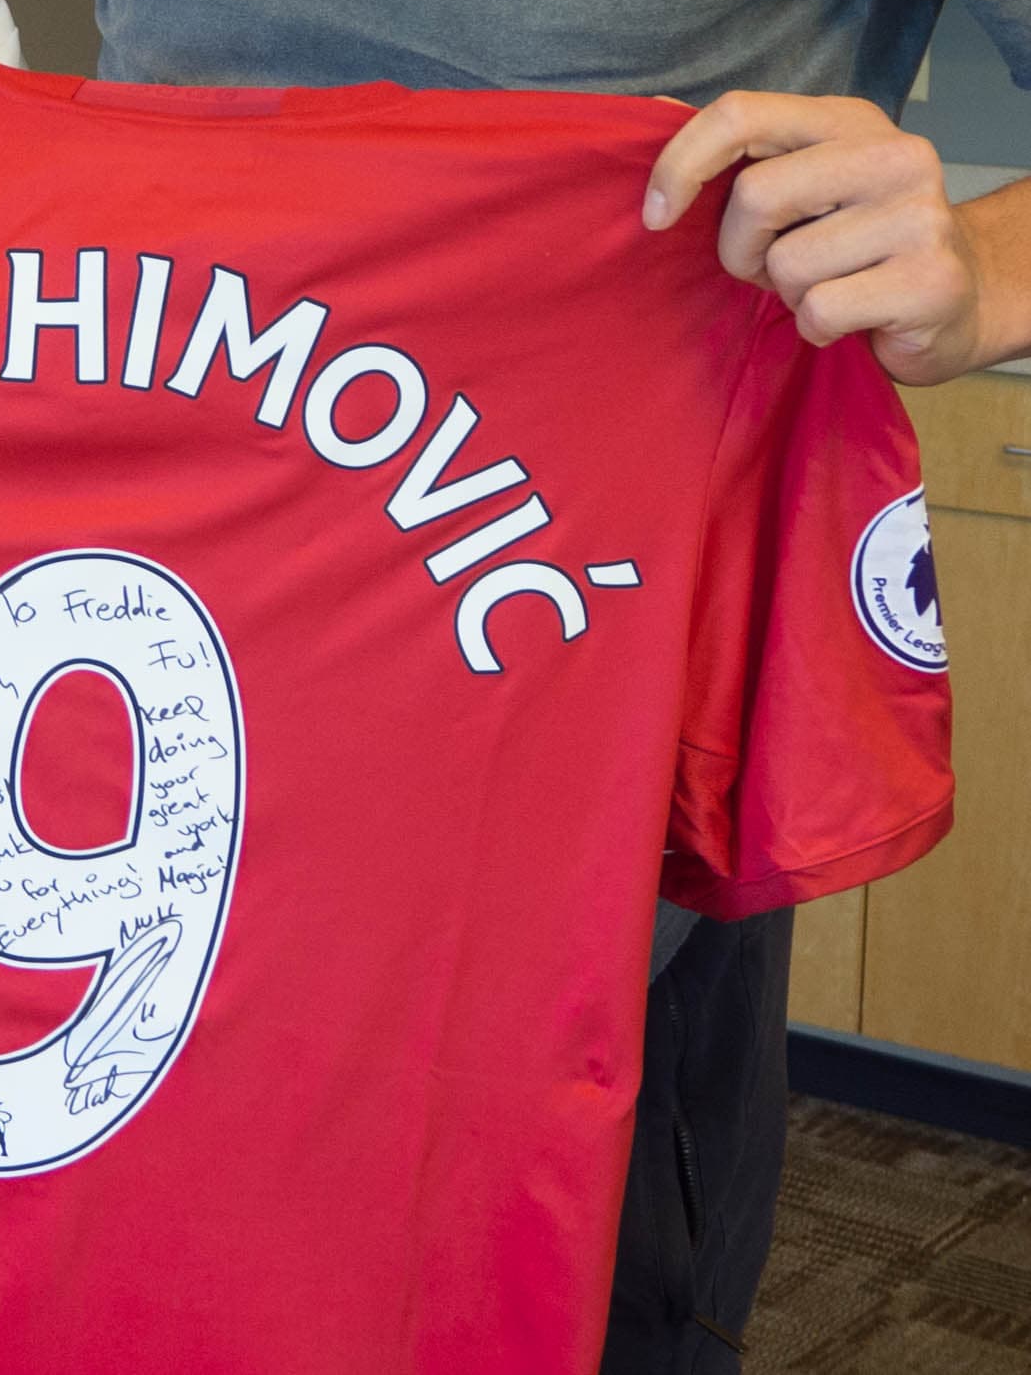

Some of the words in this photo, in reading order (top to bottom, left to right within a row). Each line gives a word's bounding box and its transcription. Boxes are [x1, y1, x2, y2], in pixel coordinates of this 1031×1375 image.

[62, 585, 172, 623] Freddie
[872, 577, 903, 633] Premier
[147, 639, 212, 670] Fu!
[148, 732, 228, 764] doing
[149, 766, 200, 799] your
[148, 787, 210, 827] great
[177, 804, 238, 837] work
[164, 828, 205, 859] and
[21, 877, 61, 900] for
